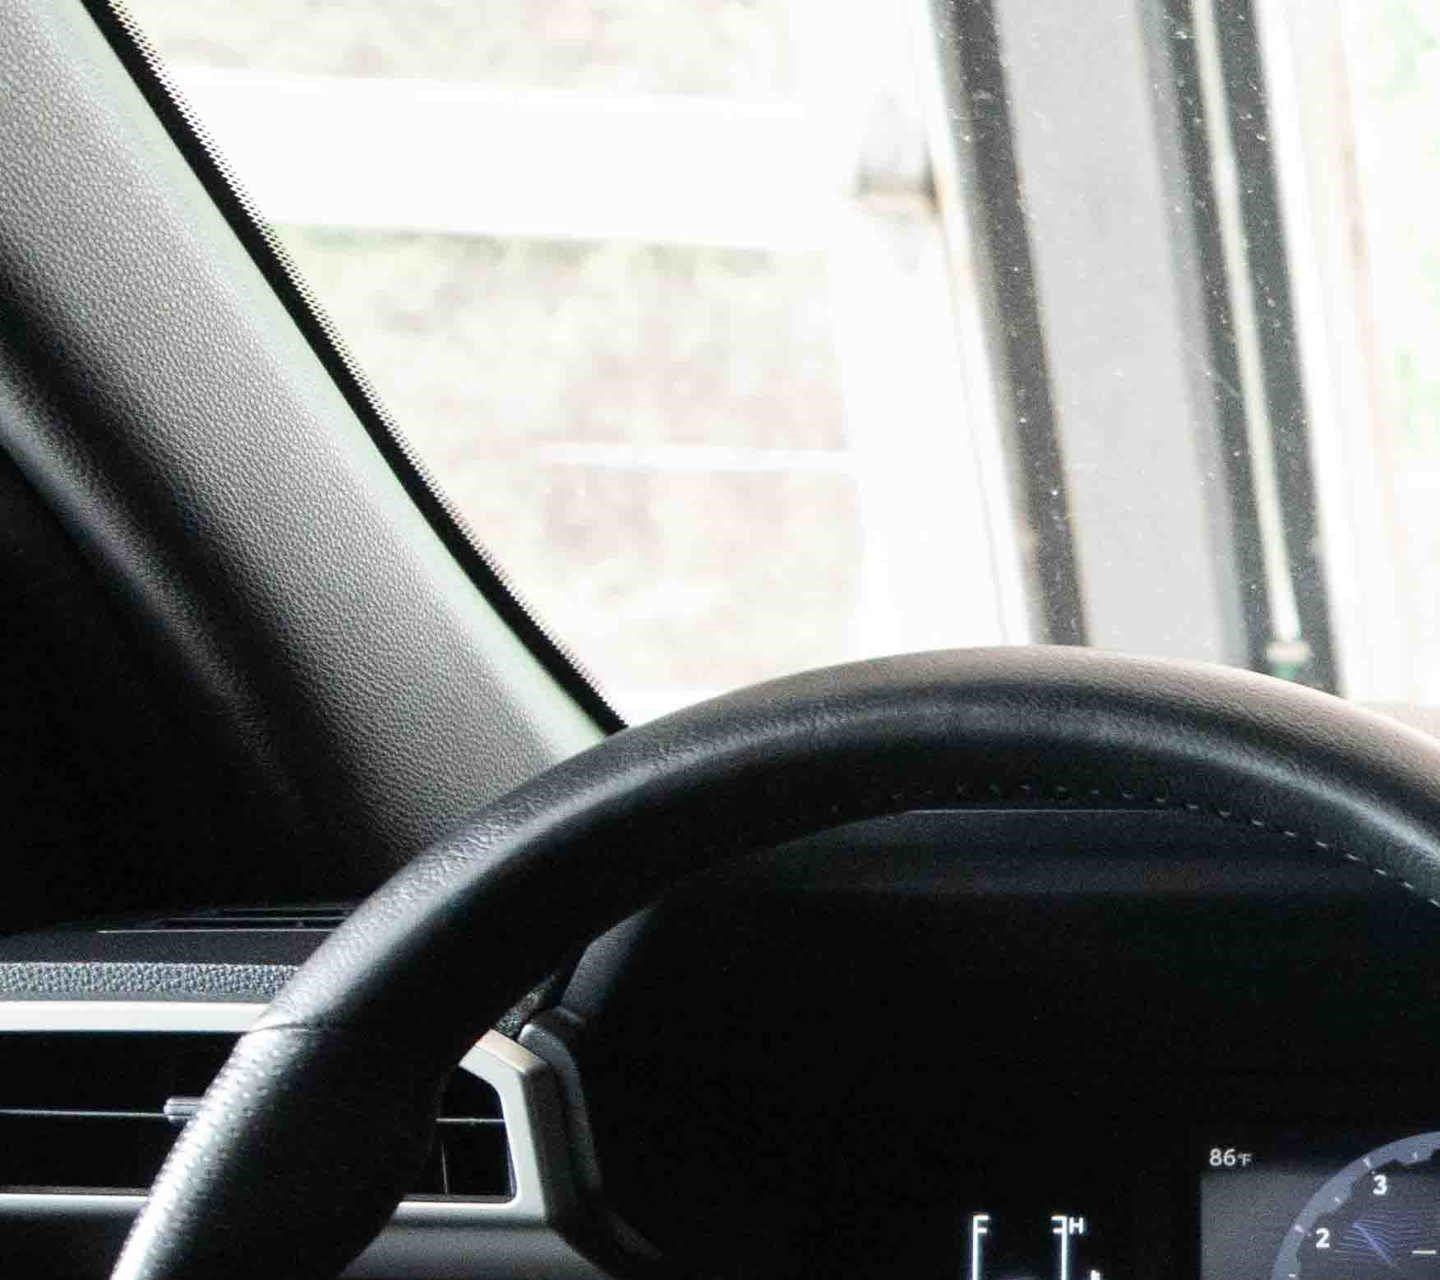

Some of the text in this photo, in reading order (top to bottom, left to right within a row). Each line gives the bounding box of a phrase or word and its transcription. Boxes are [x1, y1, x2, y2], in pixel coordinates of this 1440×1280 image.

[1373, 1174, 1387, 1195] 3
[1069, 1217, 1084, 1234] H
[1316, 1228, 1330, 1248] 2
